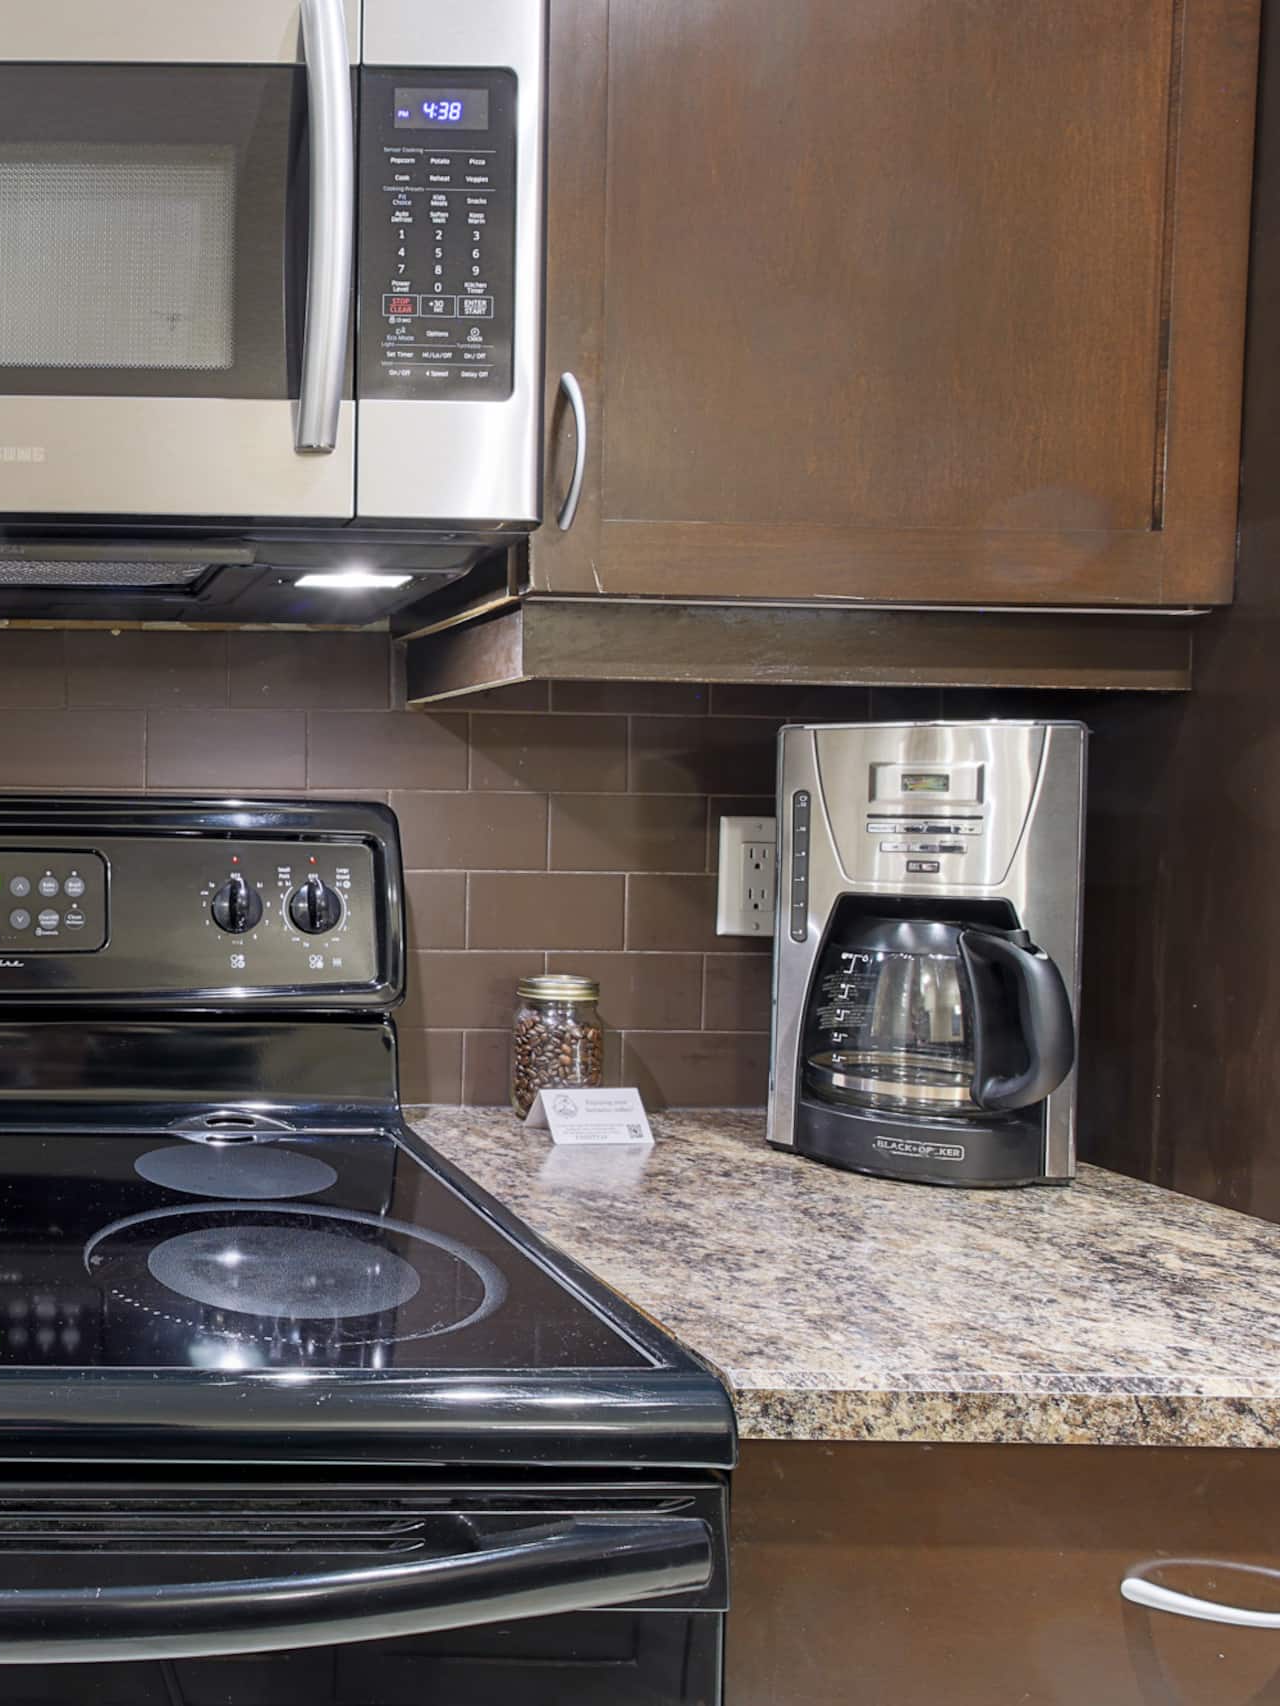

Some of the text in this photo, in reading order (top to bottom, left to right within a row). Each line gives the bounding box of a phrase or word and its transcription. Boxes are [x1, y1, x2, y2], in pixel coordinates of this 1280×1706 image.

[423, 102, 461, 120] 4:38
[399, 229, 405, 240] 1
[435, 229, 443, 241] 2
[472, 230, 480, 241] 3
[397, 247, 406, 257] 4
[435, 247, 443, 259] 5
[472, 248, 480, 259] 6
[397, 263, 406, 275] 7
[434, 264, 443, 276] 8
[471, 265, 480, 277] 9
[434, 282, 443, 293] 0
